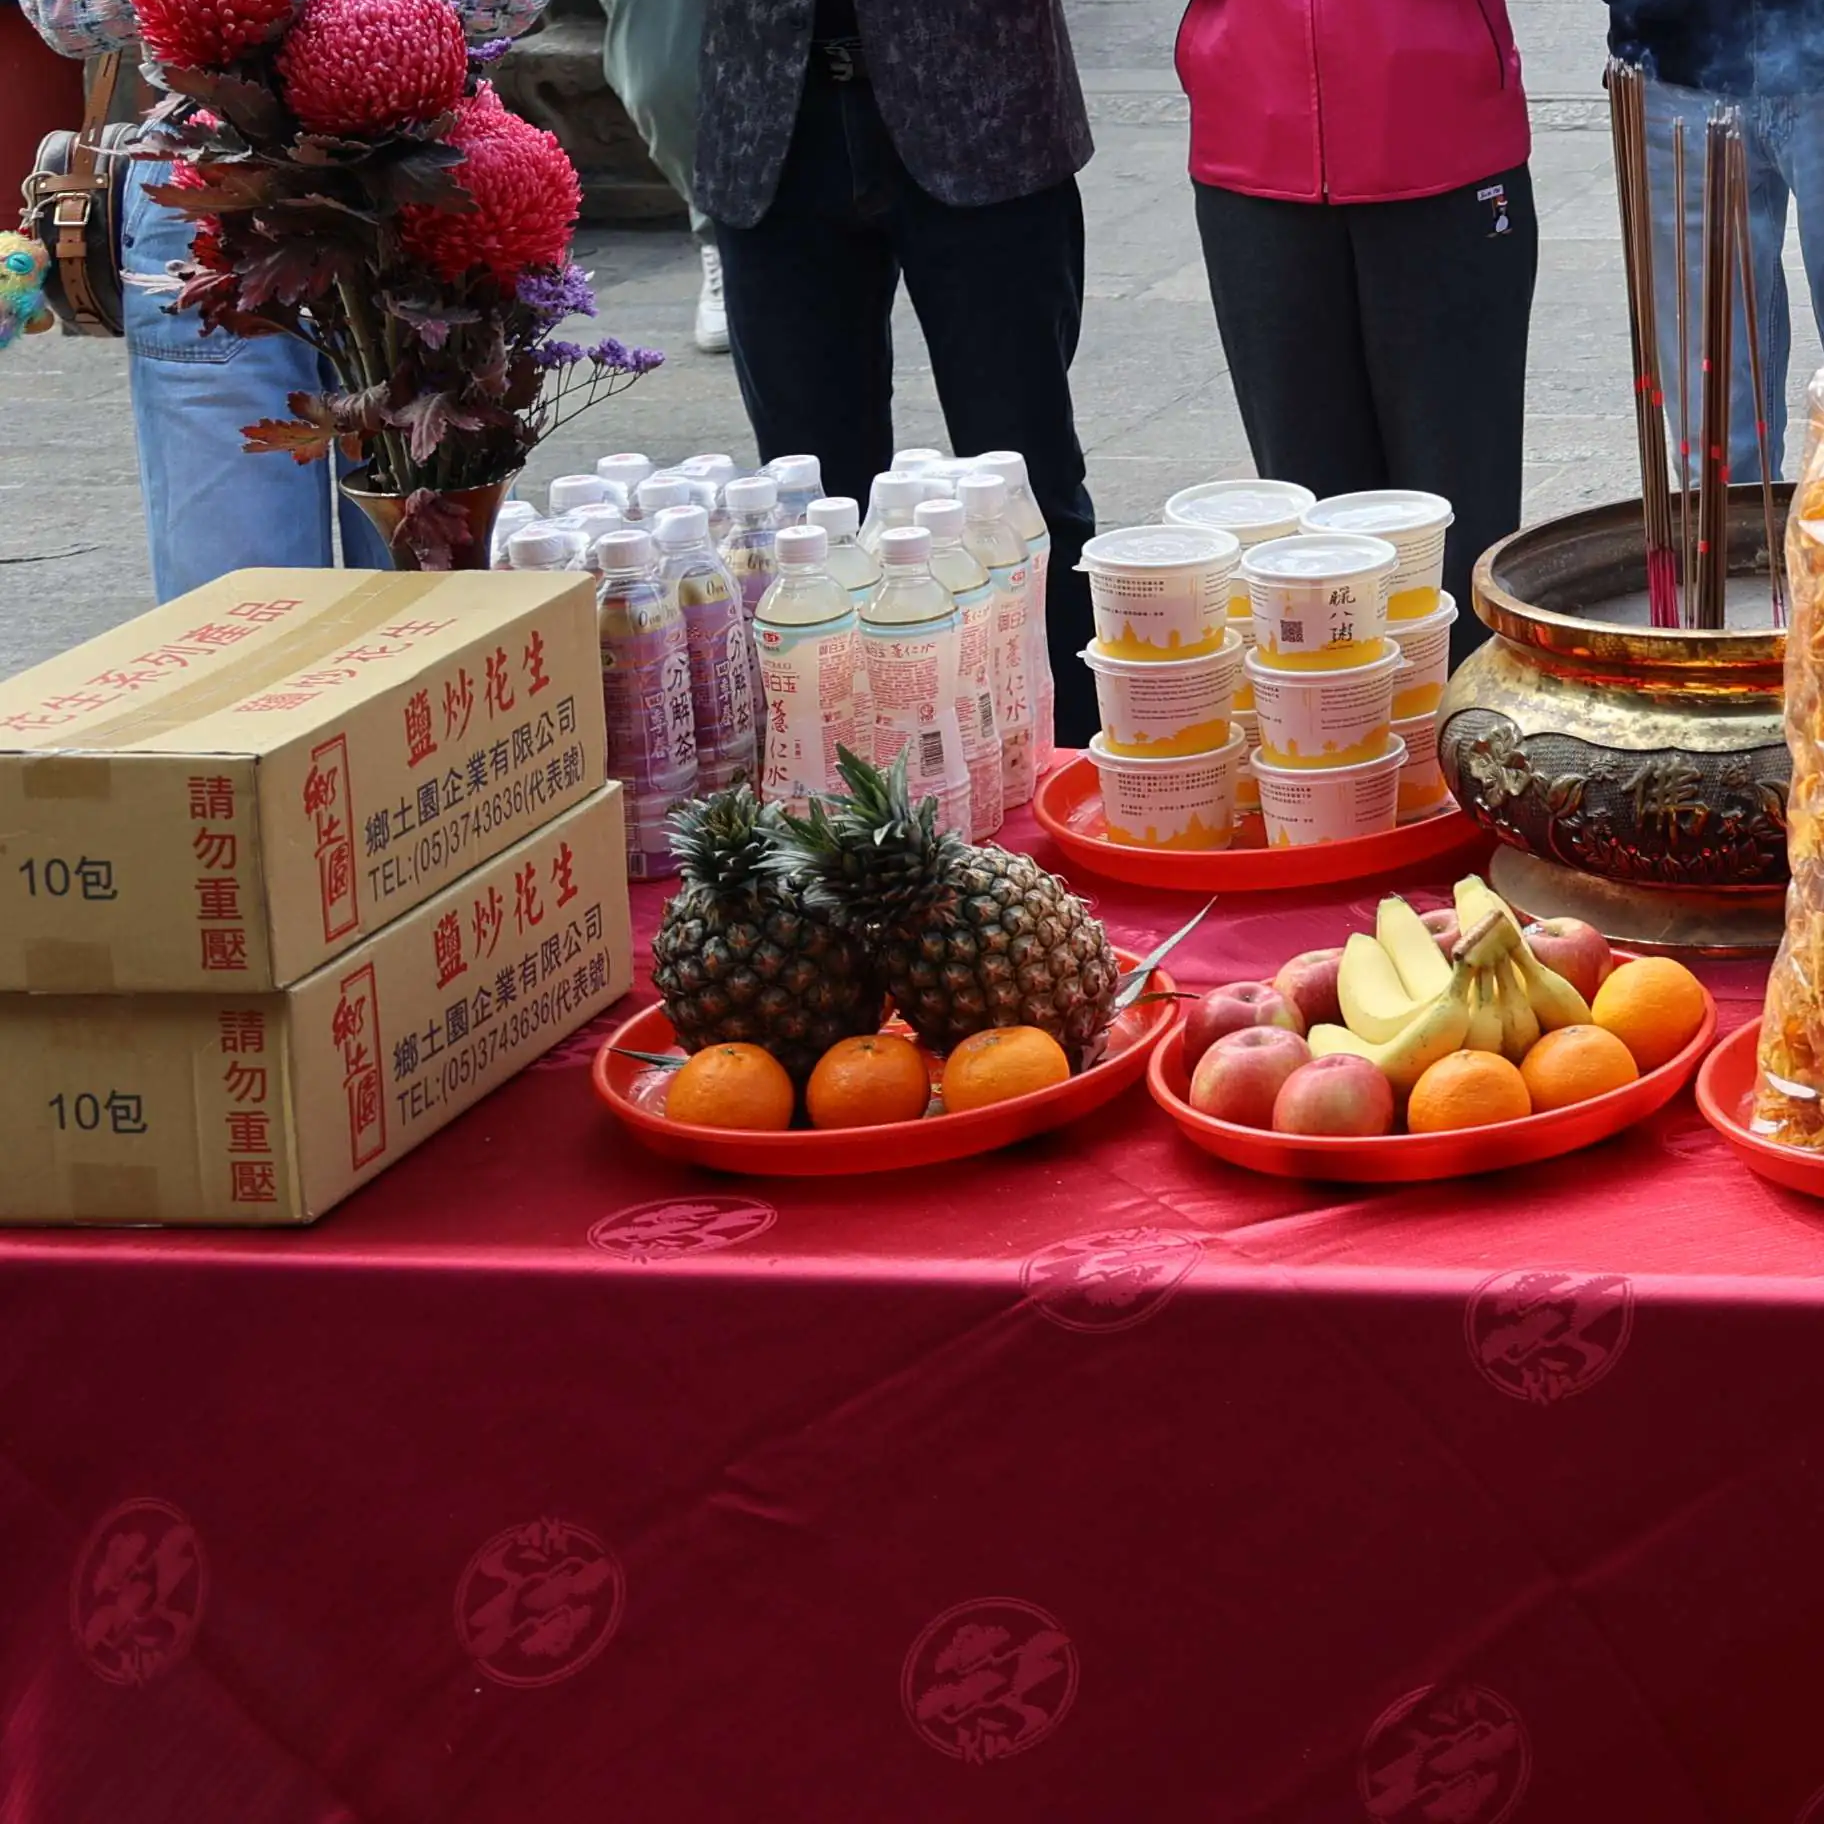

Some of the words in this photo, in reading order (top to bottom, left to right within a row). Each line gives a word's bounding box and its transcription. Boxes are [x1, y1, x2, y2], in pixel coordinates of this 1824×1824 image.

[0, 599, 303, 733] 花生系列產品
[232, 617, 458, 714] 鹽炒花生
[403, 630, 552, 769] 鹽炒花生
[666, 651, 694, 767] 分解茶
[364, 694, 578, 858] 鄉土園企業有限公司
[367, 740, 586, 903] TEL:(05)3743636(代表號)
[18, 854, 119, 902] 10包
[187, 775, 248, 972] 請勿重壓
[432, 841, 579, 991] 鹽炒花生
[392, 902, 604, 1083] 鄉土園企業有限公司
[395, 946, 612, 1127] TEL:(05)3743636(代表號)
[47, 1090, 149, 1136] 10包
[217, 1009, 278, 1204] 請勿重壓
